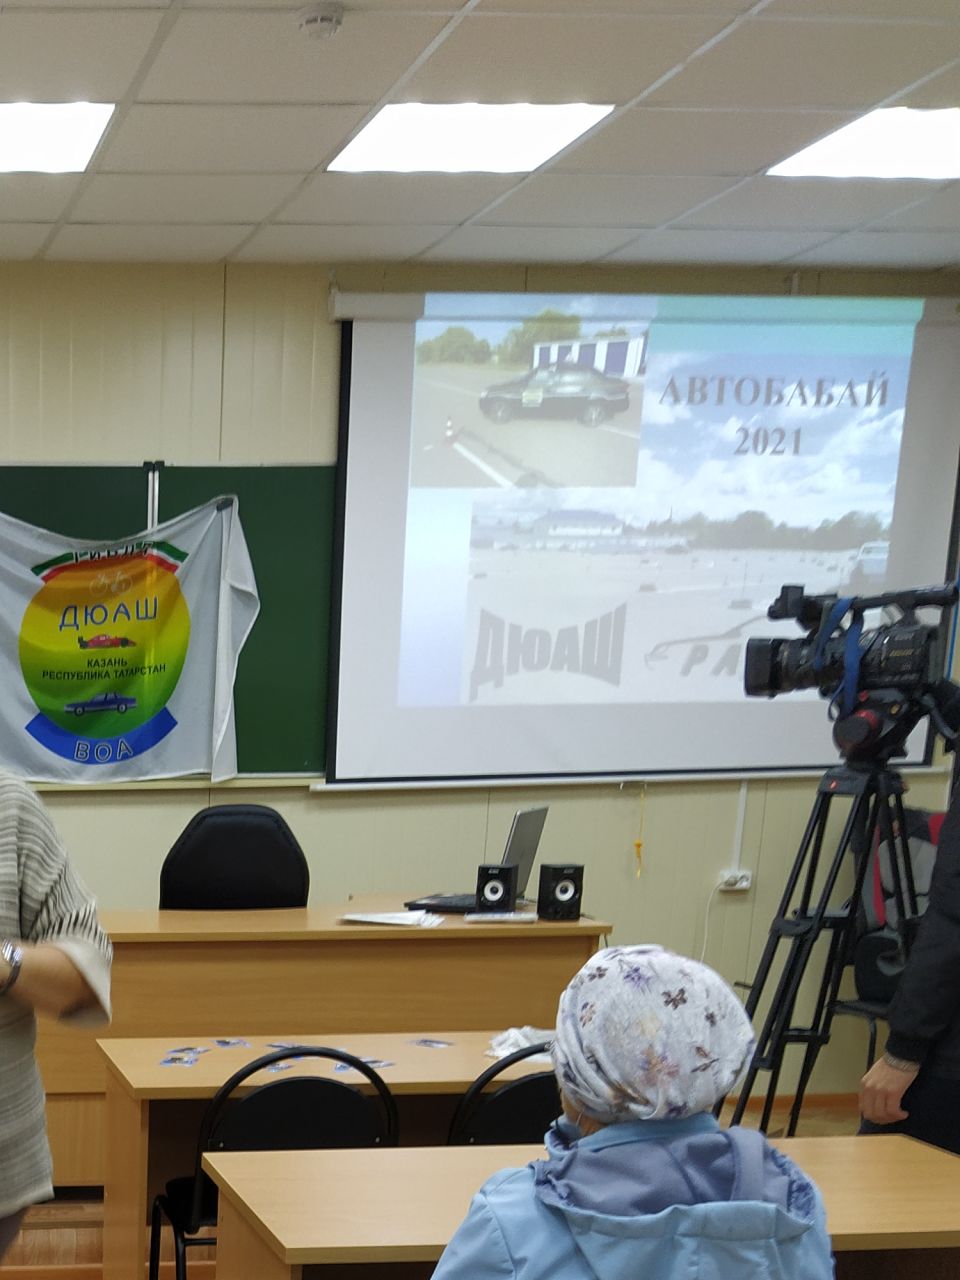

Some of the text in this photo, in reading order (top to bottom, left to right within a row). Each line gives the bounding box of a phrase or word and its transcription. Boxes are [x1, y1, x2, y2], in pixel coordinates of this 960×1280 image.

[659, 371, 889, 407] АВТОБАБАЙ
[734, 426, 804, 457] 2021
[59, 597, 158, 631] ДЮАШ
[87, 658, 128, 668] КАЗАНЬ
[470, 601, 628, 702] ДЮАШ
[42, 664, 166, 681] РЕСПУБЛИКА ТАТАРСТАН
[74, 740, 134, 762] ВОА
